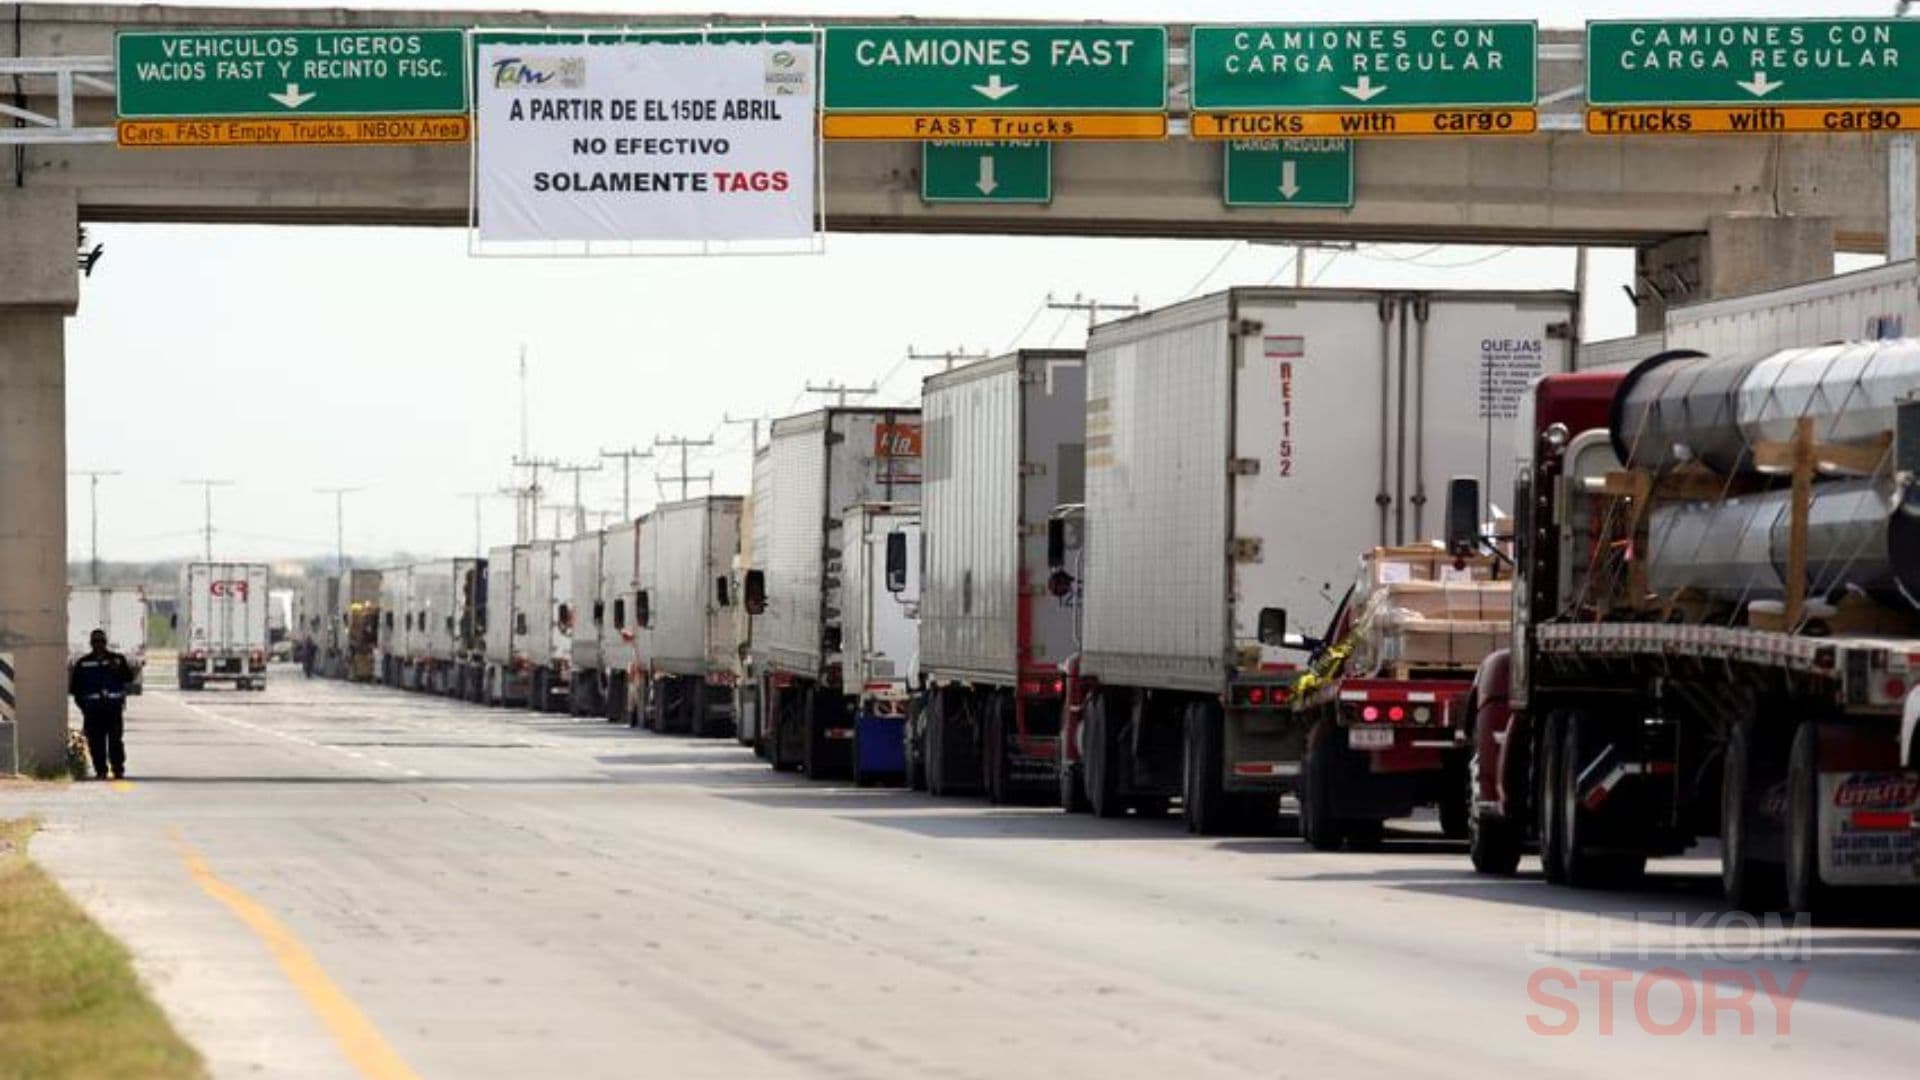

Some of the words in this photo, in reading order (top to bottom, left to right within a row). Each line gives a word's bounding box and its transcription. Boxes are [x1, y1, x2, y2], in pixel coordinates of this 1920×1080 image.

[162, 37, 299, 57] VEHICULOS
[316, 36, 421, 55] LIGEROS
[1235, 30, 1406, 49] CAMIONES
[1432, 29, 1494, 48] CON
[1631, 27, 1804, 46] CAMIONES
[1829, 26, 1890, 44] CON
[856, 40, 1030, 66] CAMIONES
[1051, 40, 1134, 66] FAST
[1225, 54, 1334, 73] CARGA
[1353, 52, 1503, 72] REGULAR
[1621, 50, 1729, 69] CARGA
[1751, 49, 1899, 68] REGULAR
[136, 61, 206, 81] VACIOS
[216, 60, 265, 79] FAST
[277, 60, 292, 79] Y
[304, 59, 388, 79] RECINTO
[399, 58, 447, 77] FISC.
[510, 99, 524, 121] A
[531, 99, 604, 121] PARTIR
[611, 99, 636, 121] DE
[722, 99, 782, 121] ABRIL
[1602, 110, 1692, 130] Trucks
[1729, 109, 1785, 129] with
[1824, 109, 1900, 129] cargo
[177, 124, 222, 140] FAST
[229, 122, 280, 142] Empty
[420, 120, 460, 137] Area
[915, 118, 977, 134] FAST
[990, 118, 1074, 134] Trucks
[1212, 114, 1303, 133] Trucks
[1340, 112, 1395, 131] with
[1434, 111, 1512, 131] cargo
[573, 138, 606, 155] NO
[616, 138, 730, 154] EFECTIVO
[534, 172, 707, 192] SOLAMENTE
[714, 172, 789, 192] TAGS
[1481, 339, 1541, 352] QUEJAS
